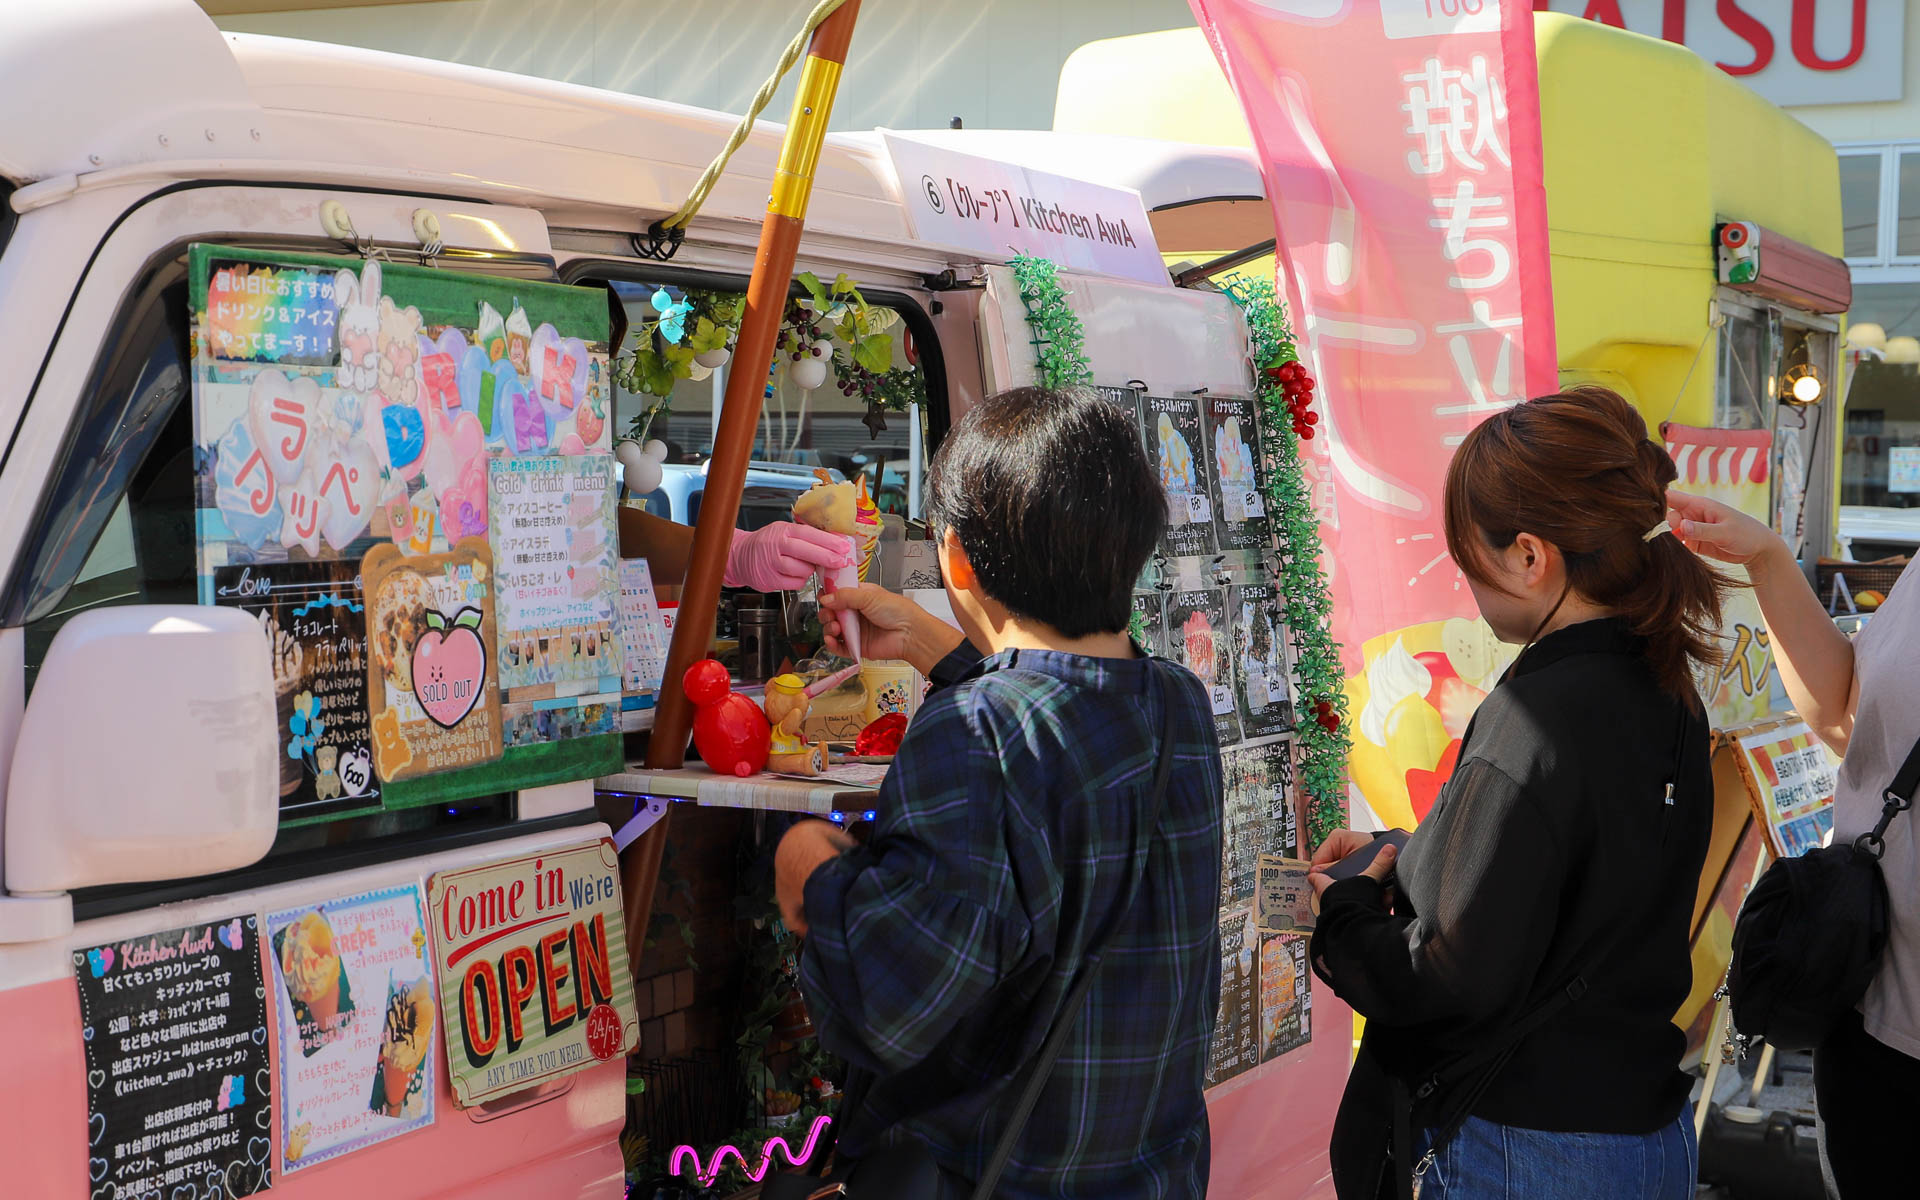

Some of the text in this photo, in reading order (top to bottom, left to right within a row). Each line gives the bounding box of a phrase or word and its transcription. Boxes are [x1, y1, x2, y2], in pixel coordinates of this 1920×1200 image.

[1020, 196, 1095, 241] Kitchen
[1096, 213, 1136, 249] AwA
[216, 272, 335, 299] 暑い日におすすめ
[1180, 416, 1198, 428] クレープ
[1214, 401, 1243, 414] バナナいちご
[495, 474, 605, 494] Cold drink menu
[1178, 592, 1209, 607] いちごいちご
[1240, 586, 1267, 598] チョコチョコ
[294, 618, 338, 637] チョコレート
[1206, 606, 1223, 620] クレープ
[423, 680, 471, 703] SOLD OUT
[1261, 868, 1278, 878] 1000
[442, 879, 525, 943] Come
[534, 858, 567, 913] in
[121, 926, 215, 970] Kitchen AwA
[103, 955, 220, 993] 甘くてもっちりクレープの
[157, 972, 231, 1001] キッチンカーです
[460, 911, 613, 1068] OPEN
[121, 1014, 226, 1051] など色々な場所に出店中
[589, 1017, 619, 1048] 24/7
[487, 1042, 583, 1087] ANY TIME YOU NEED
[145, 1098, 212, 1130] 出店依頼受付中
[116, 1130, 240, 1178] イベント、地域のお祭りなど
[115, 1160, 216, 1200] お気軽にご相談下さい。
